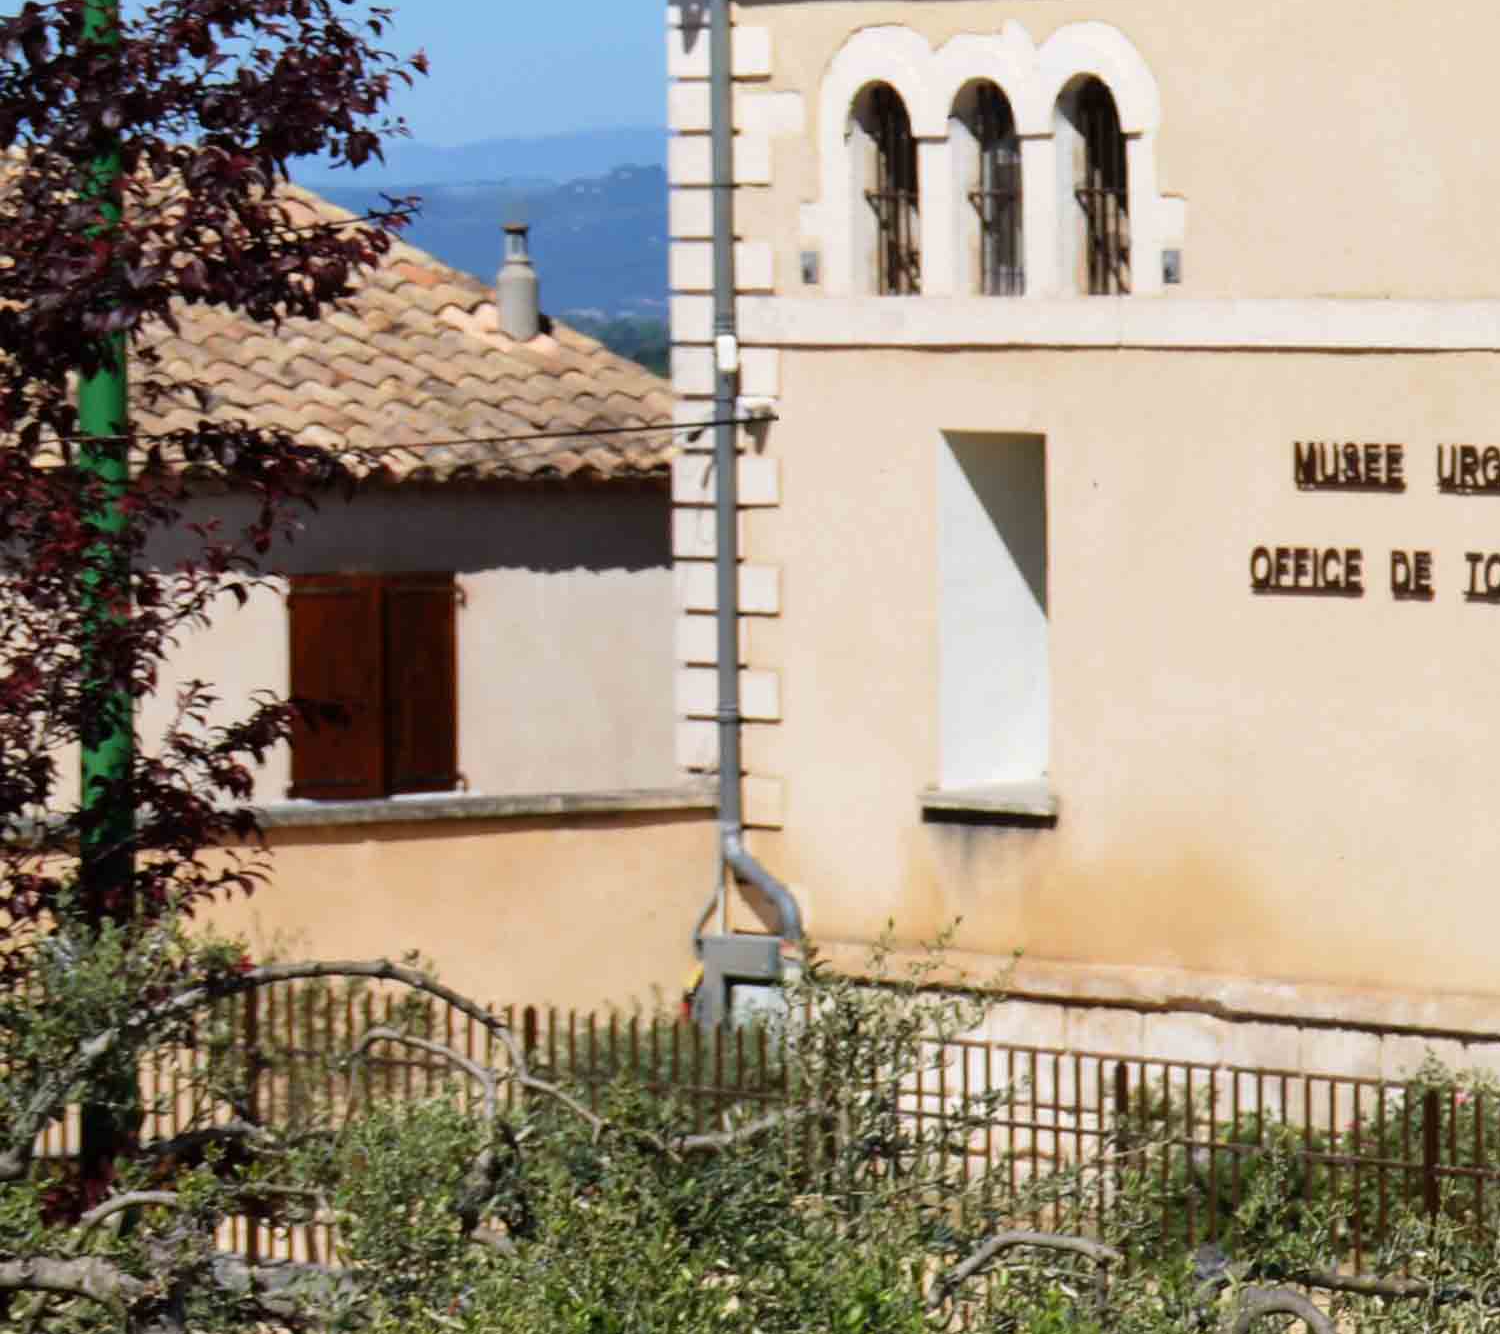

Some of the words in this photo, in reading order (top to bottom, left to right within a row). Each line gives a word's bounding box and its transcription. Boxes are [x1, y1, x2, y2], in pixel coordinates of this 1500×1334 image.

[1294, 440, 1406, 490] MUSEE
[1250, 546, 1363, 596] OFFICE
[1389, 549, 1434, 599] DE
